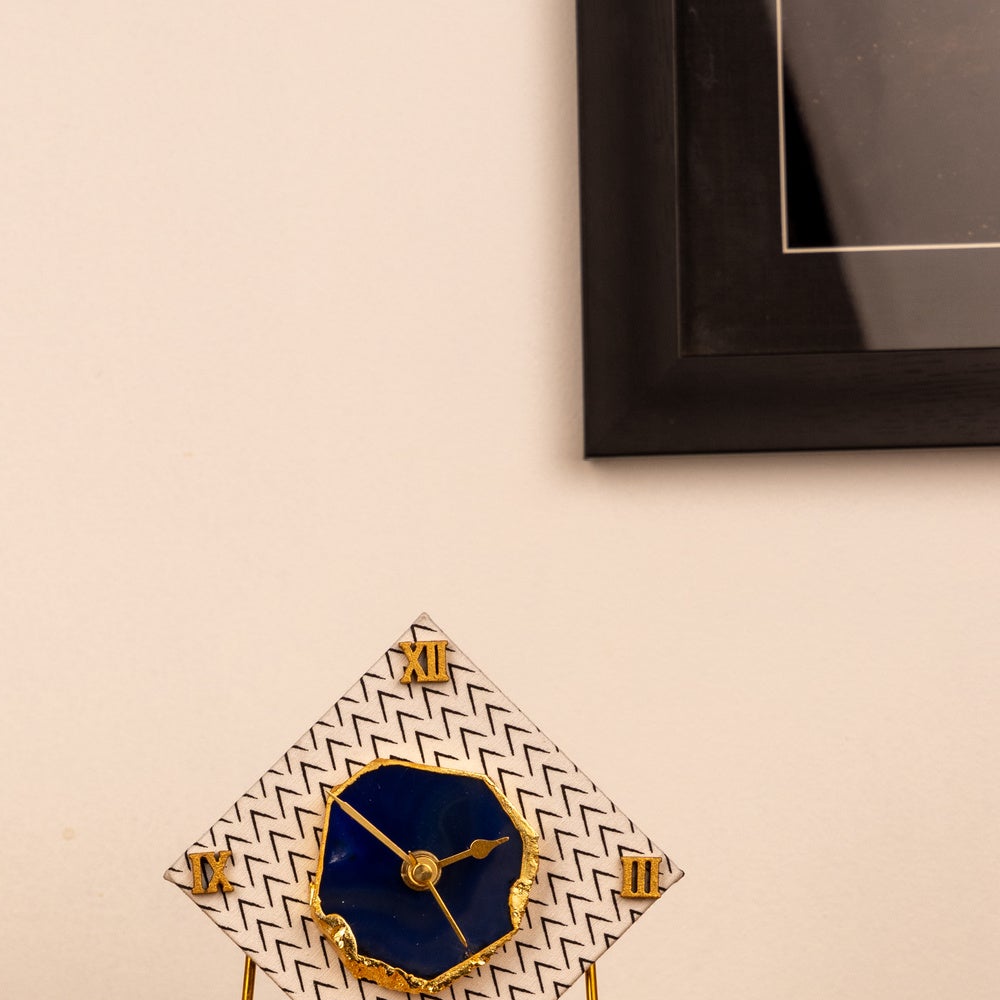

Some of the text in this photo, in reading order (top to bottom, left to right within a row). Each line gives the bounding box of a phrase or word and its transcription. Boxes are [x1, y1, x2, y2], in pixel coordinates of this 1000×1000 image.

[399, 640, 449, 684] XII
[189, 850, 234, 895] IX
[620, 856, 662, 900] III
